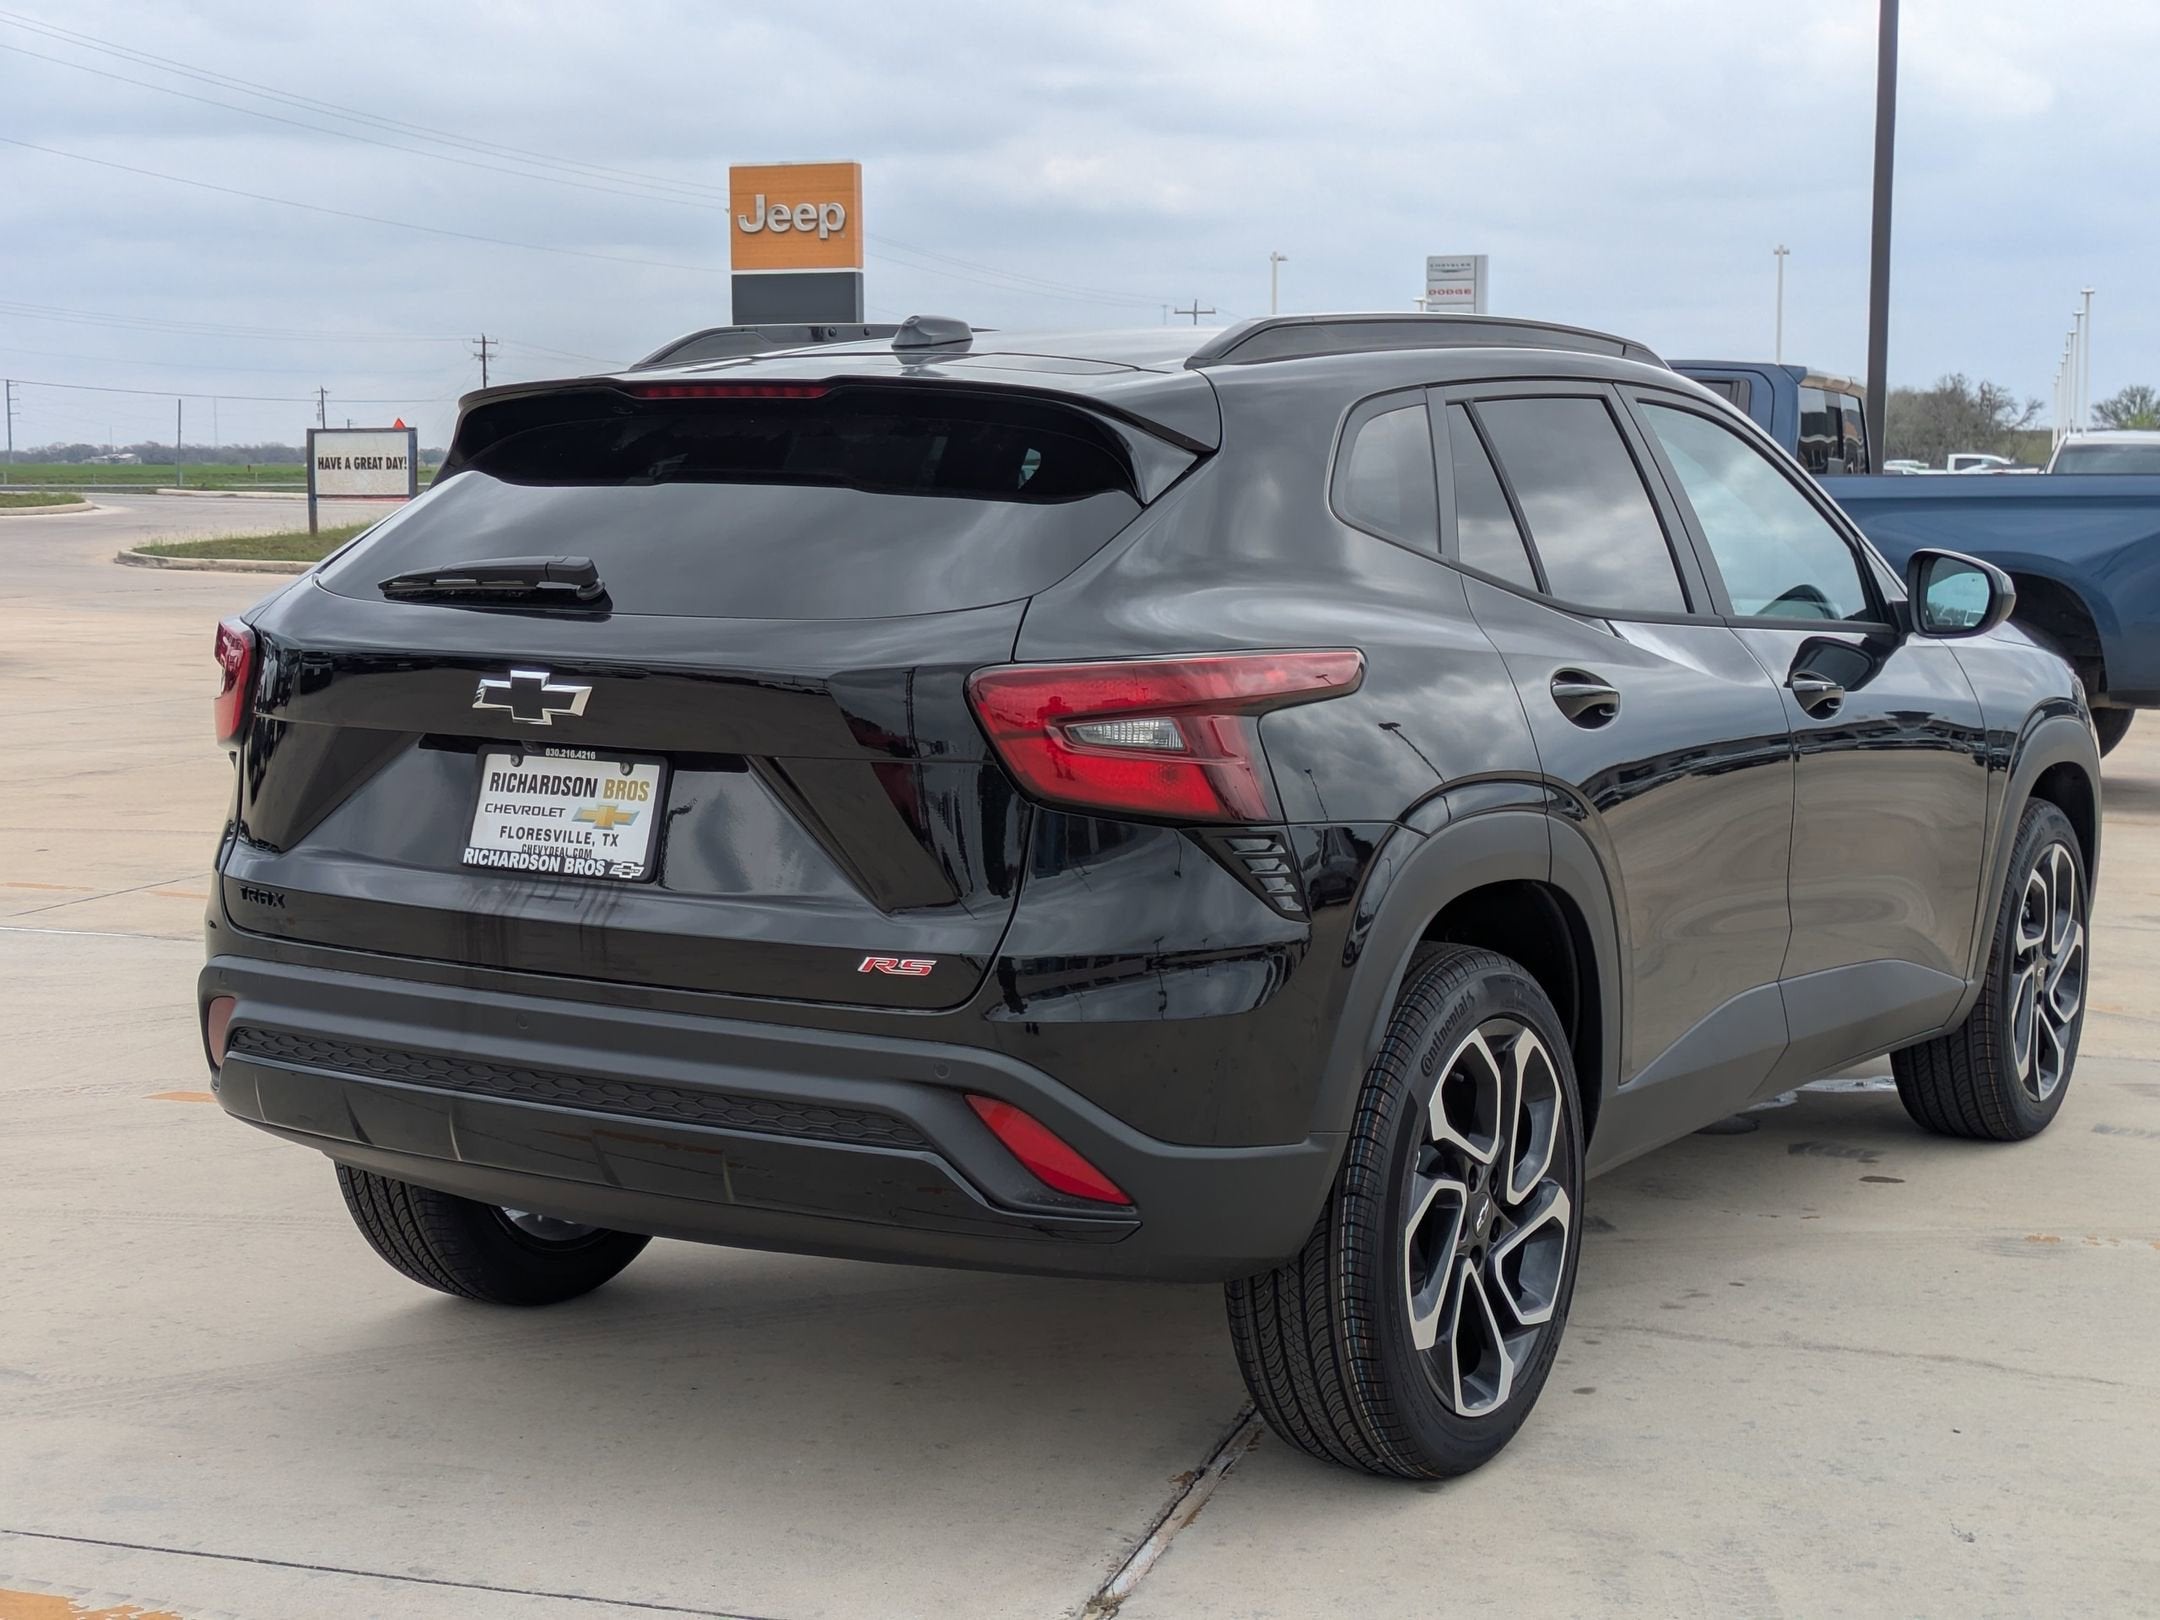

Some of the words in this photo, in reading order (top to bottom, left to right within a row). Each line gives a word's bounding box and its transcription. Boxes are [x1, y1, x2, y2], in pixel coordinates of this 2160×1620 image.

[737, 194, 846, 239] Jeep
[1428, 288, 1473, 296] DODGE
[317, 456, 342, 470] HAVE
[344, 456, 352, 470] A
[353, 456, 383, 470] GREAT
[385, 456, 408, 470] DAY!
[489, 772, 598, 798] RICHARDSON
[602, 778, 650, 802] BROS
[484, 803, 566, 818] CHEVROLET
[499, 825, 595, 847] FLORESVILLE,
[602, 833, 619, 847] TX
[463, 848, 560, 872] RICHARDSON
[563, 858, 606, 877] BROS
[858, 956, 937, 976] RS
